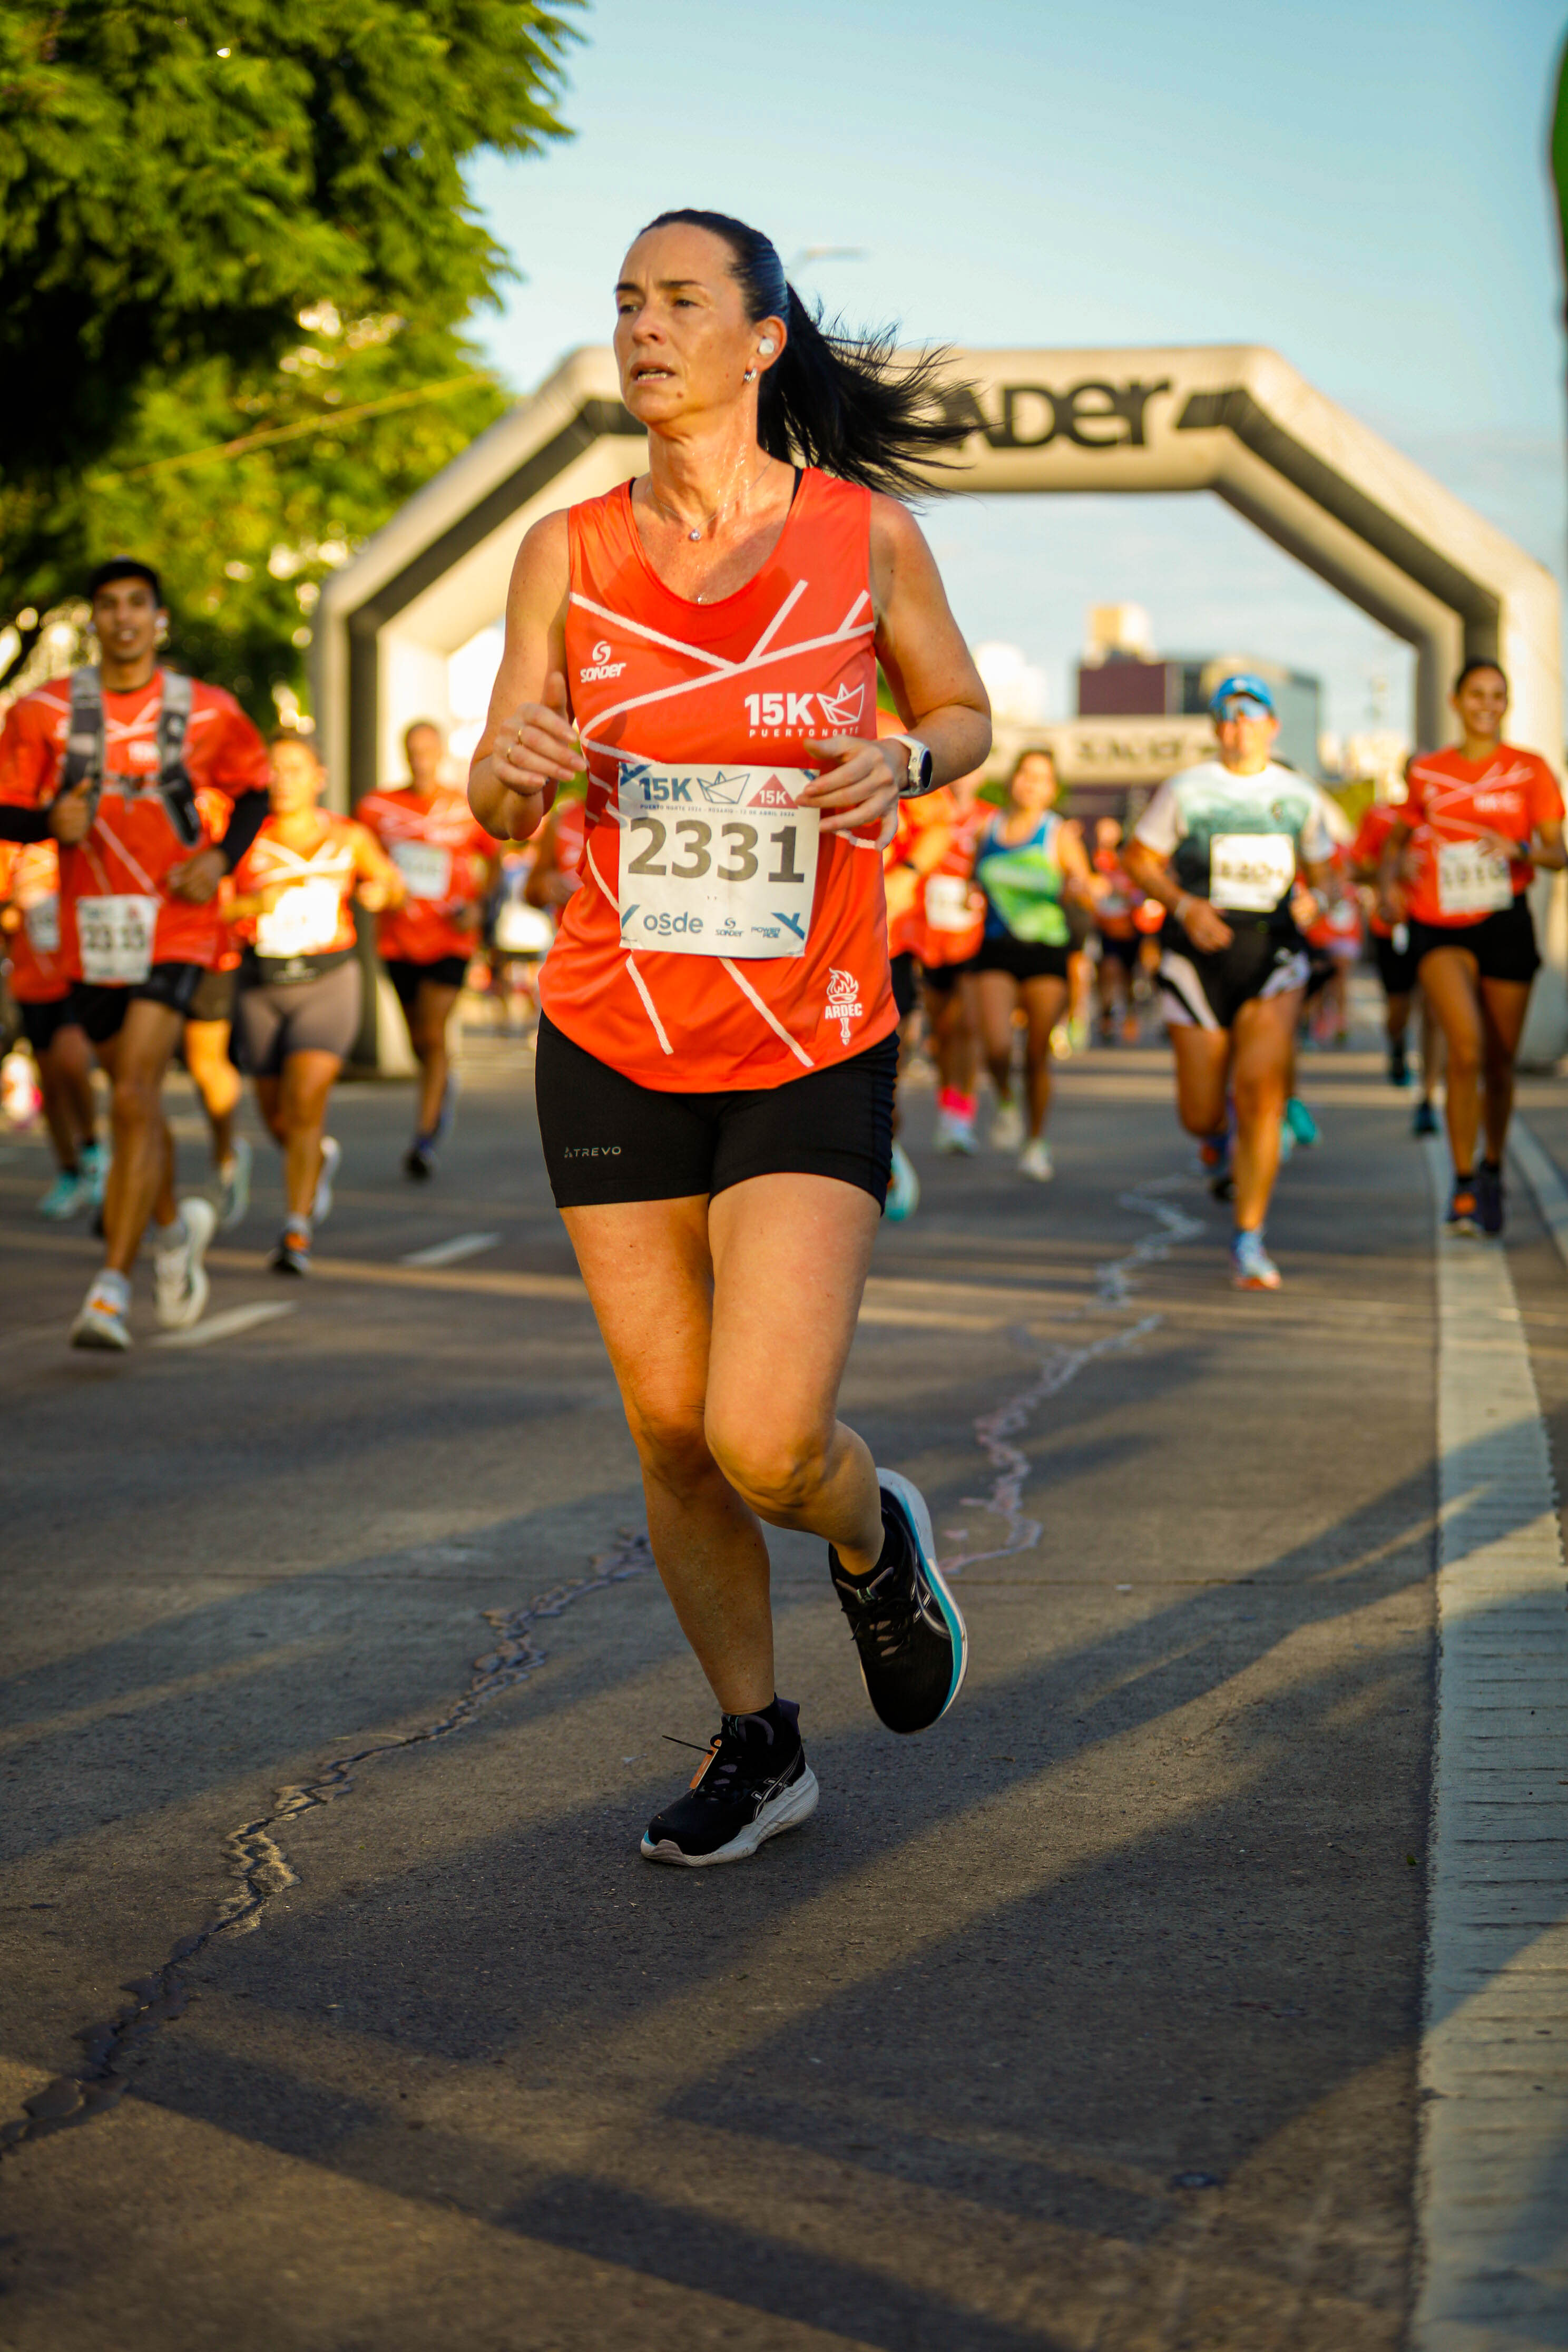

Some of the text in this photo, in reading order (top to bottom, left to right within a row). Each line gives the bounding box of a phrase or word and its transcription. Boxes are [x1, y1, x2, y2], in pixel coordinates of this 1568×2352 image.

[744, 693, 815, 726] 15K
[749, 726, 859, 738] PUERTO NORTE
[639, 778, 692, 802] 15K
[759, 790, 787, 805] 15K
[628, 817, 804, 883] 2331
[643, 911, 703, 936] osde
[825, 1003, 863, 1019] ARDEC
[564, 1146, 621, 1158] ATREVO
